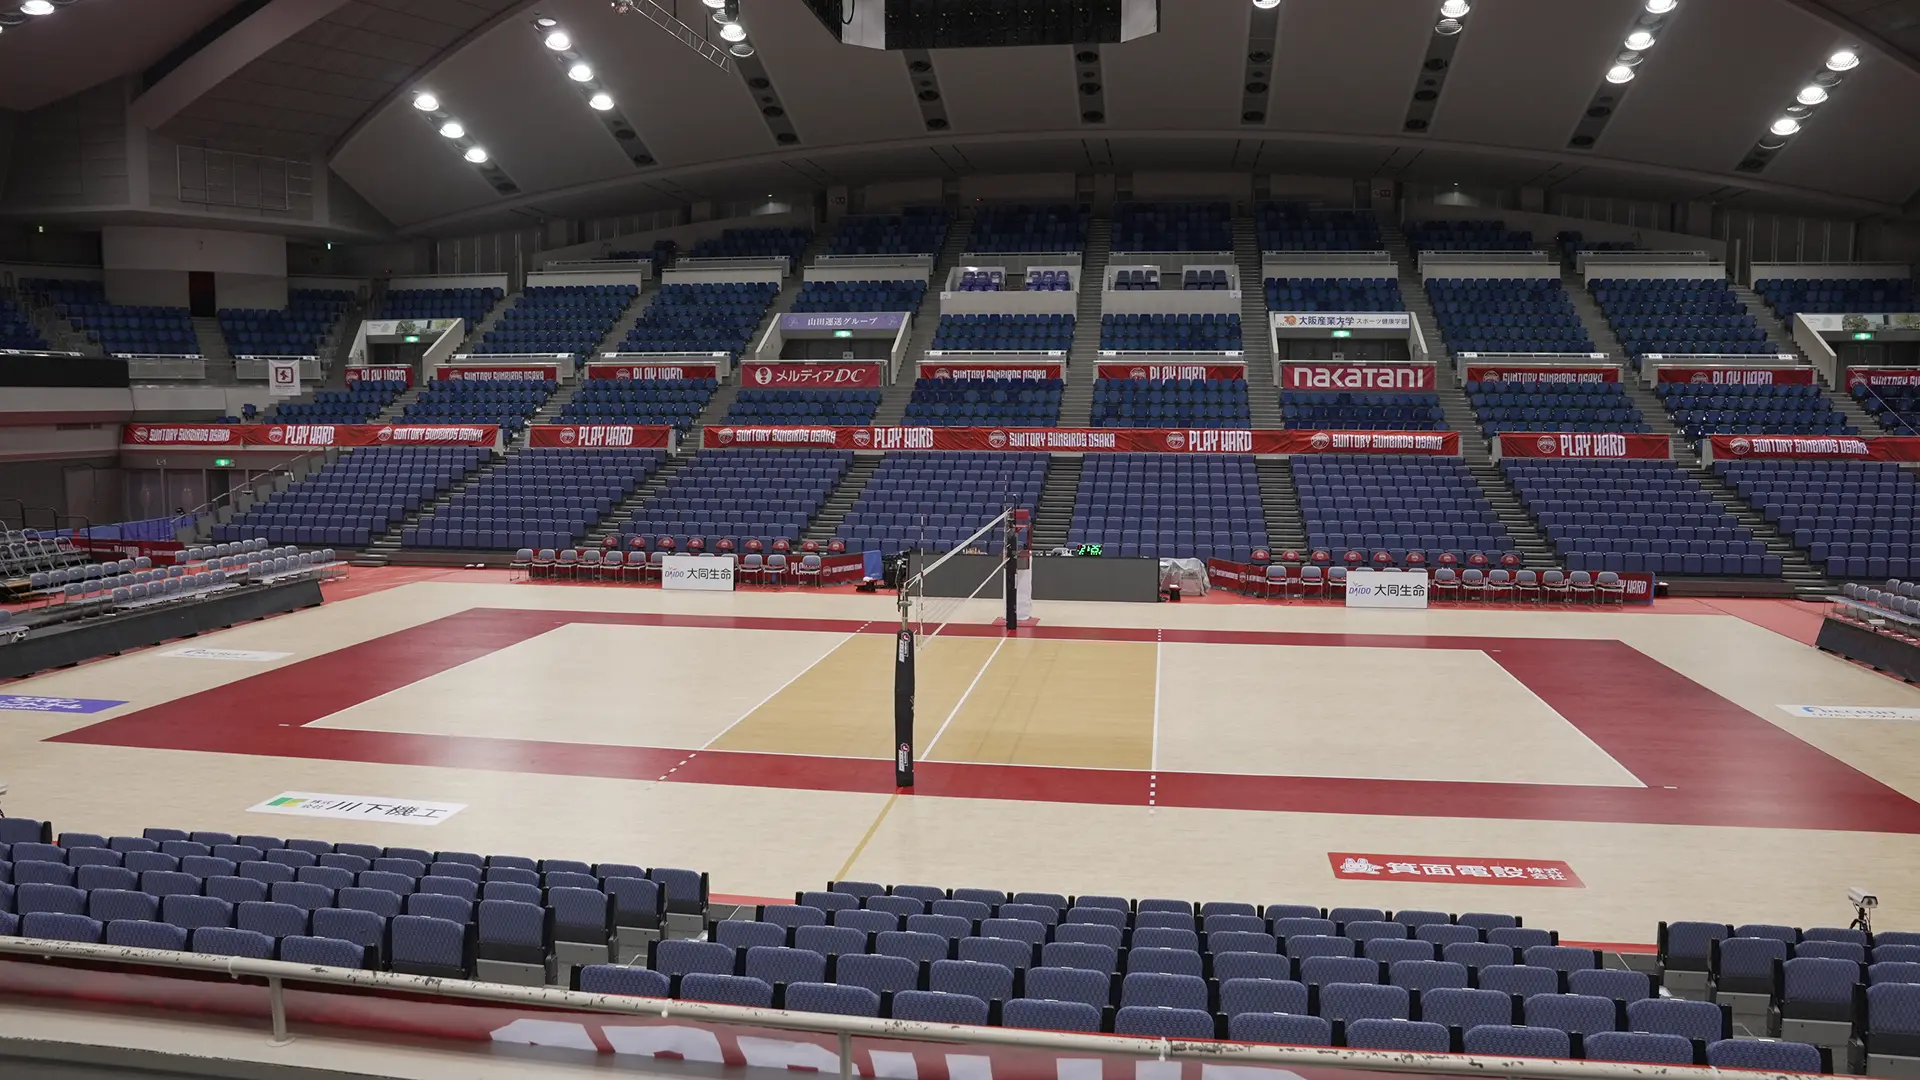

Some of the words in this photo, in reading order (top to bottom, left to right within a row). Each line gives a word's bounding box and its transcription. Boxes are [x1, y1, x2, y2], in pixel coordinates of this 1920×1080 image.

[808, 317, 878, 326] 山田運送グループ
[1299, 316, 1355, 326] 大阪産業大学
[1356, 317, 1408, 326] スポーツ健康学部
[776, 368, 866, 383] メルディアDC
[149, 428, 177, 442] SUNTORY
[208, 429, 230, 442] OSAKA
[284, 425, 309, 445] PLAY
[310, 425, 335, 444] HARD
[393, 427, 424, 440] SUNTORY
[456, 428, 484, 442] OSAKA
[577, 426, 604, 446] PLAY
[605, 426, 634, 446] HARD
[736, 428, 771, 442] SUNTORY
[810, 429, 837, 444] OSAKA
[873, 427, 903, 449] PLAY
[903, 427, 934, 448] HARD
[1009, 432, 1047, 447] SUNTORY
[1088, 432, 1116, 447] OSAKA
[1188, 430, 1219, 452] PLAY
[1220, 430, 1253, 452] HARD
[1332, 433, 1372, 448] SUNTORY
[1415, 435, 1443, 450] OSAKA
[1560, 434, 1593, 457] PLAY
[1593, 434, 1626, 457] HARD
[1751, 438, 1793, 453] SUNTORY
[1839, 439, 1869, 455] OSAKA
[687, 568, 732, 580] 大同生命
[1348, 586, 1371, 596] DAIDO
[1374, 584, 1426, 597] 大同生命
[326, 801, 448, 819] 川下機工
[1385, 862, 1528, 879] 箕面電設
